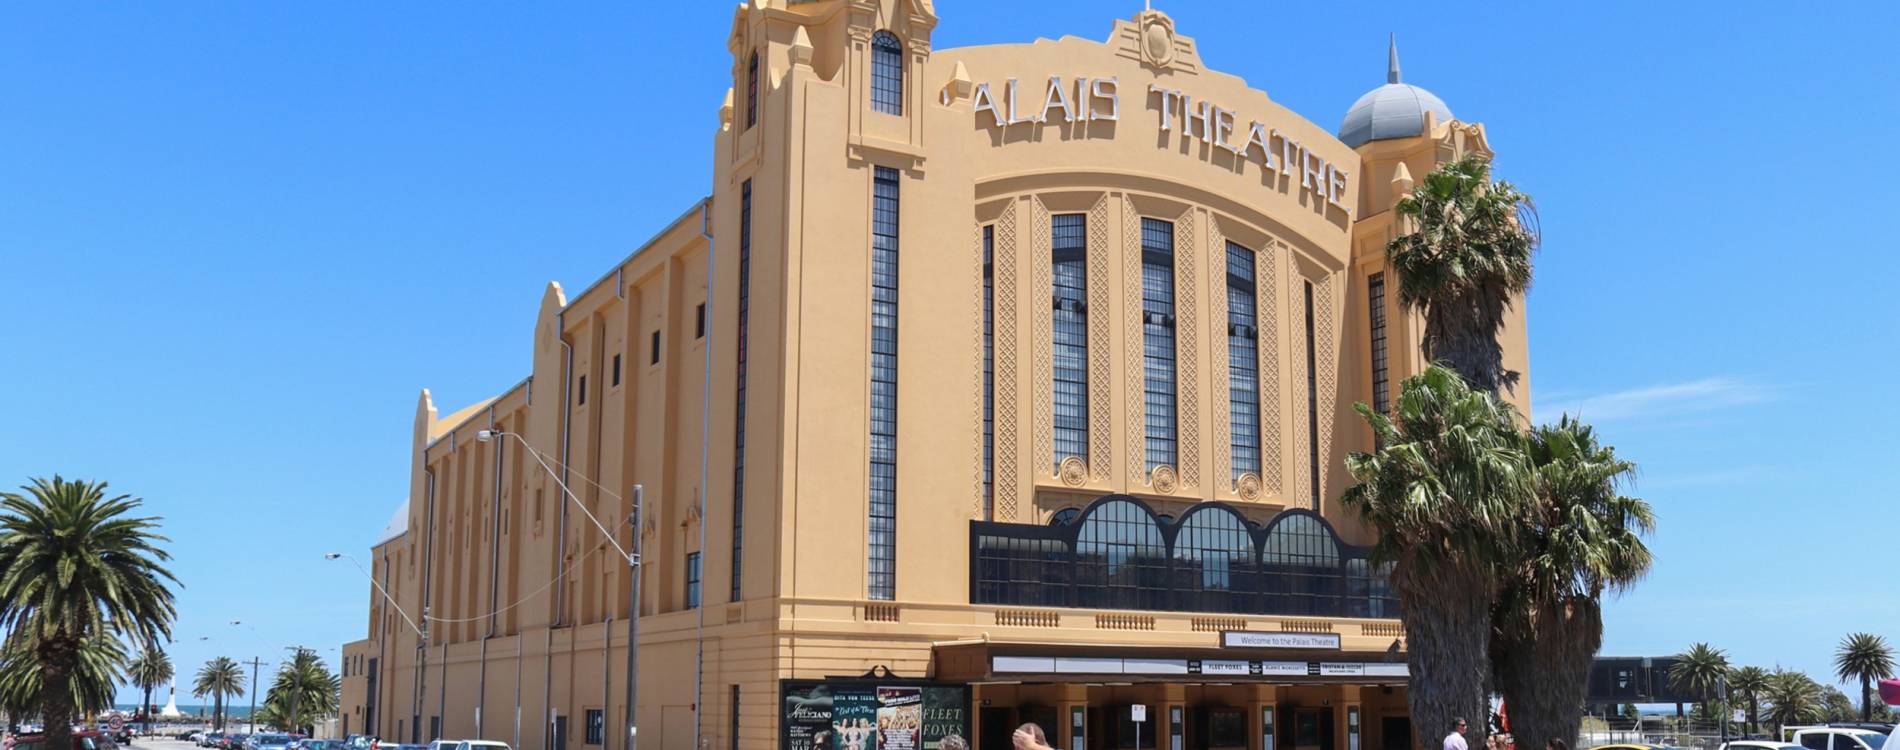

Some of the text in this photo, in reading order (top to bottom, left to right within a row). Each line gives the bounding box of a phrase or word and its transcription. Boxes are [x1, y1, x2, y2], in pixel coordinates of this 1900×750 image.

[943, 76, 1352, 215] ALAIS THEATRE
[1241, 636, 1335, 647] Welcome to the Palais Theatre
[923, 709, 962, 720] FLEET
[924, 724, 962, 736] FOXES
